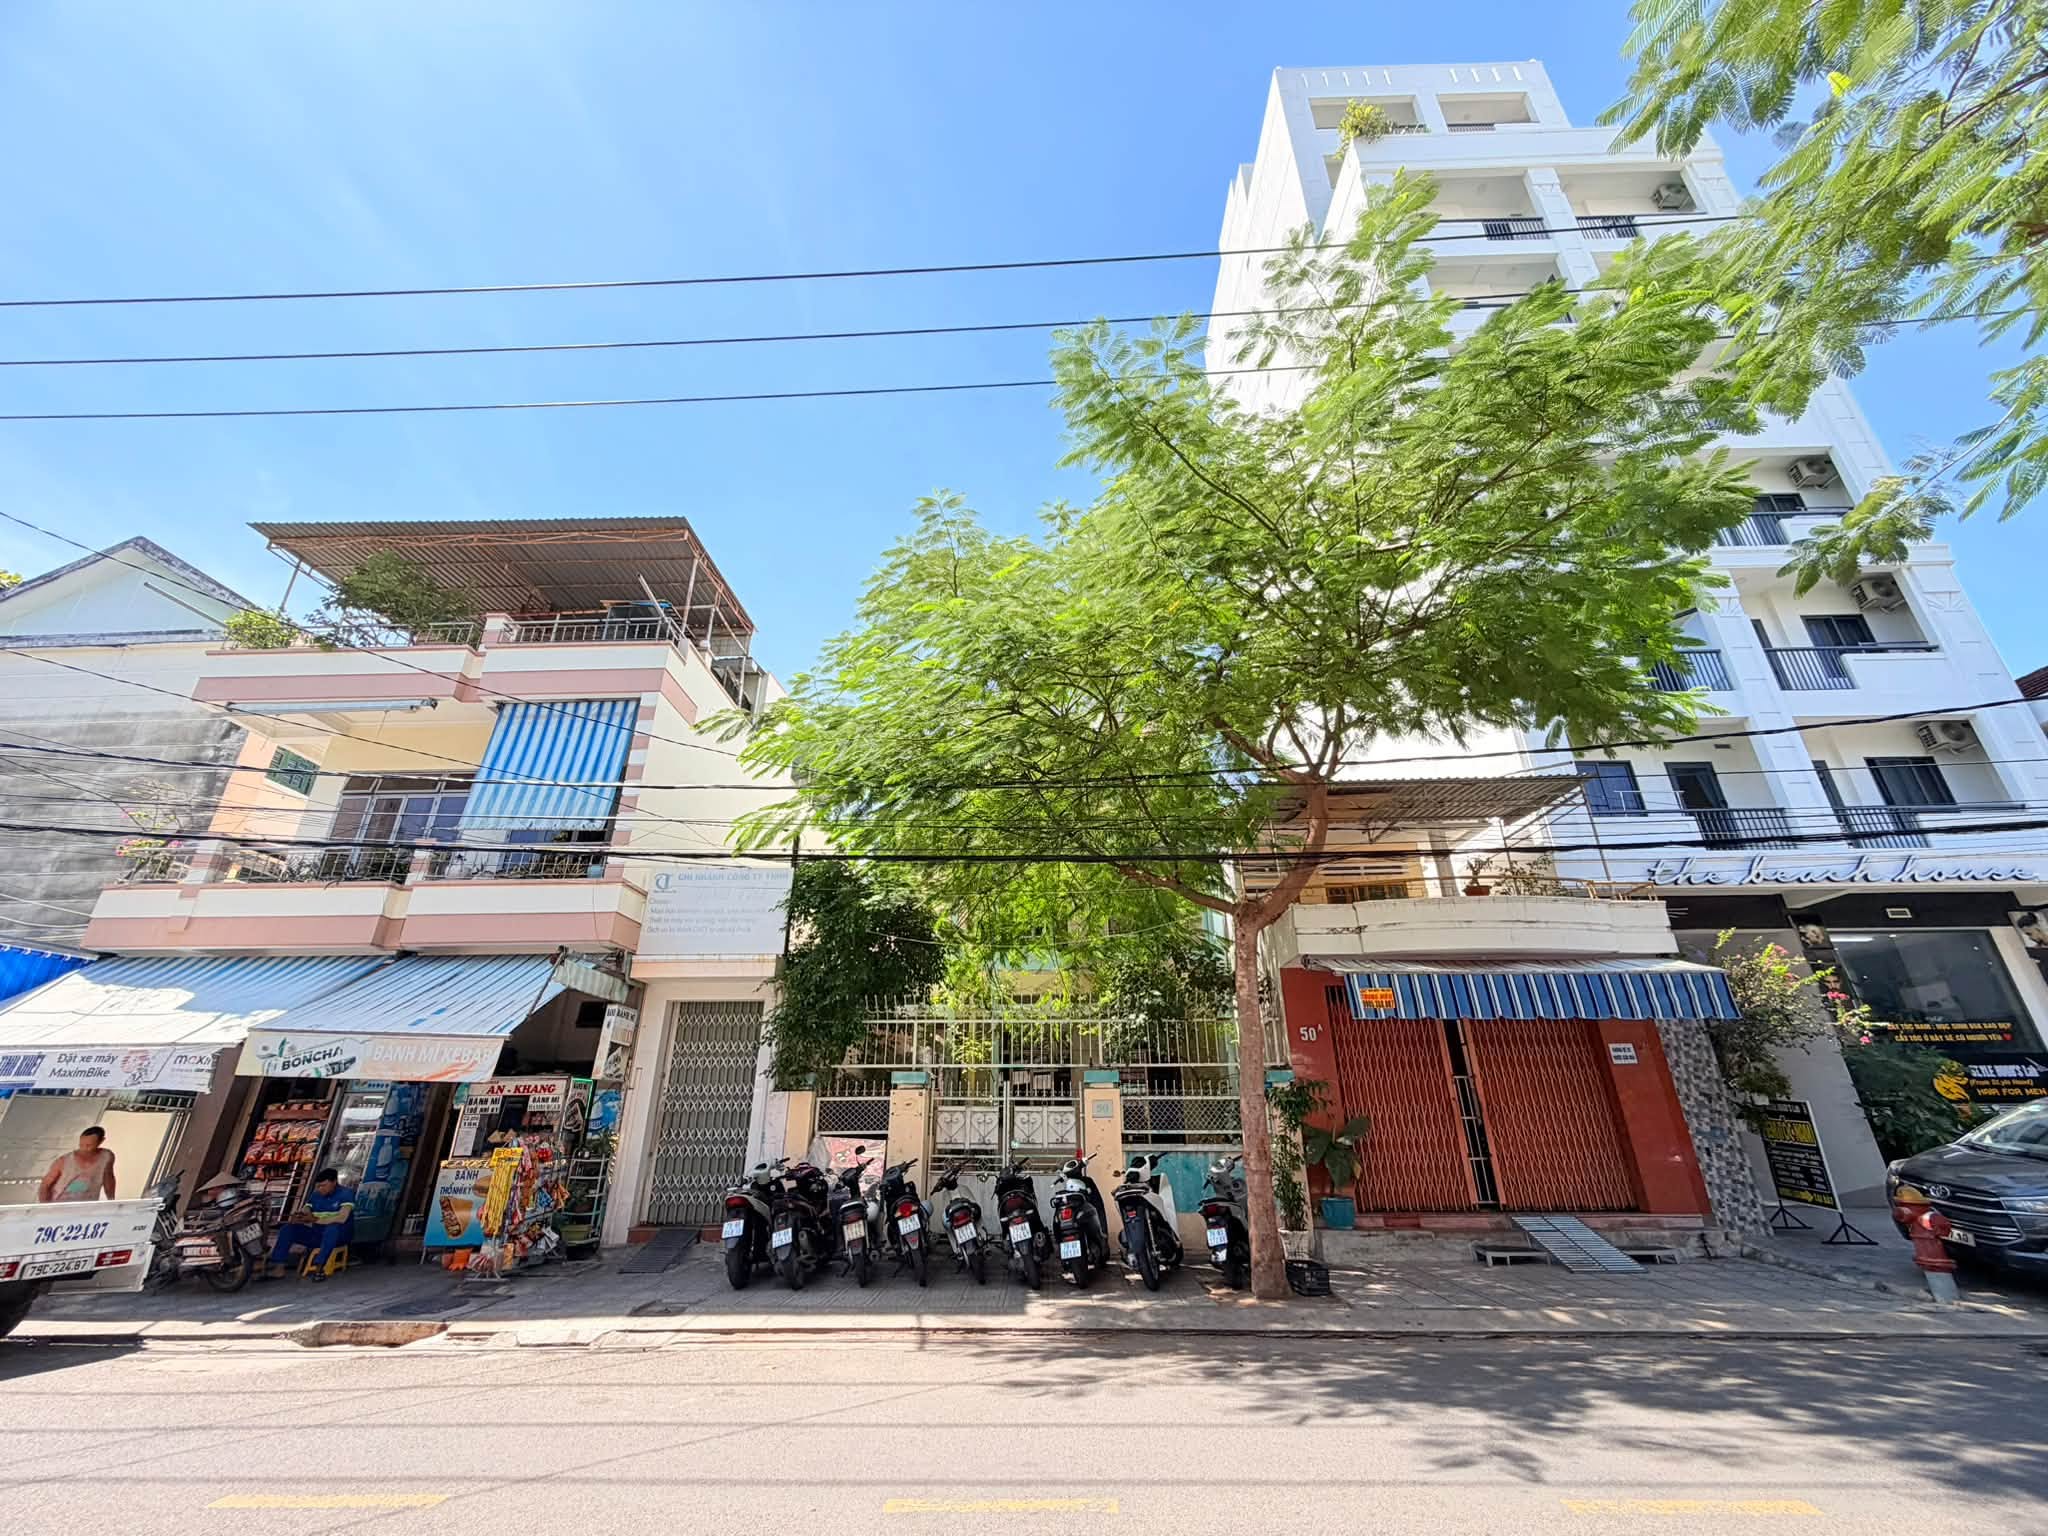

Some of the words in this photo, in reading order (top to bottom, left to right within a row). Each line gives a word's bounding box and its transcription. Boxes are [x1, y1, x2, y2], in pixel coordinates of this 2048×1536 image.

[1647, 857, 1731, 885] the
[1737, 854, 1881, 886] beach
[1892, 854, 2038, 883] house
[57, 1053, 78, 1066] Đặt
[79, 1055, 94, 1064] xe
[94, 1053, 119, 1065] máy
[50, 1067, 110, 1078] MaximBike
[486, 1085, 505, 1095] AN
[513, 1084, 557, 1094] KHANG
[1976, 1088, 2000, 1096] HAIR
[2001, 1088, 2023, 1096] FOR
[2025, 1088, 2048, 1096] MEN
[34, 1222, 110, 1244] 79C-224.87
[30, 1259, 88, 1277] 79C-224.87
